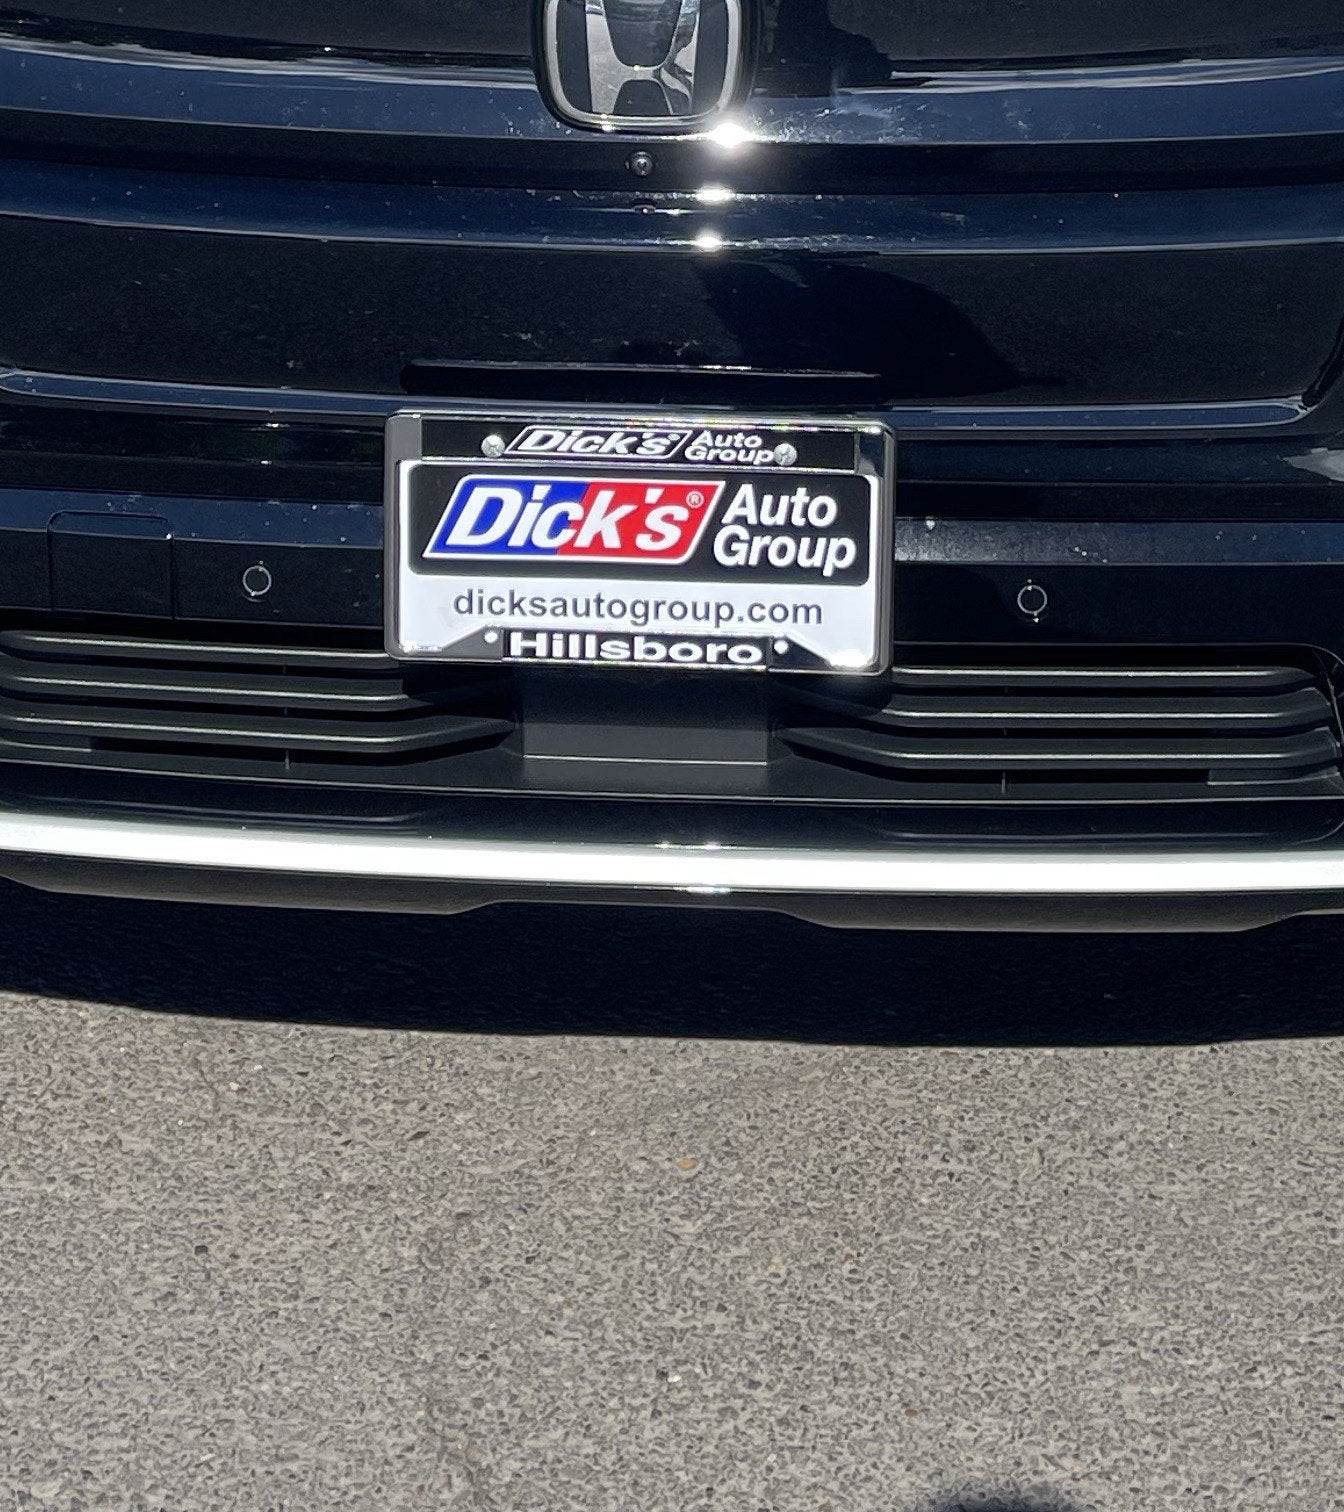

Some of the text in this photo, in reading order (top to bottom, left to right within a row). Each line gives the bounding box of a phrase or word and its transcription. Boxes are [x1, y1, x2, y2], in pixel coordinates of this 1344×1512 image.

[684, 445, 774, 466] Group
[691, 430, 763, 449] Auto
[721, 483, 838, 528] Auto
[713, 525, 857, 577] Group
[453, 588, 823, 627] dicksautogroup.com
[509, 631, 765, 665] Hillsboro
